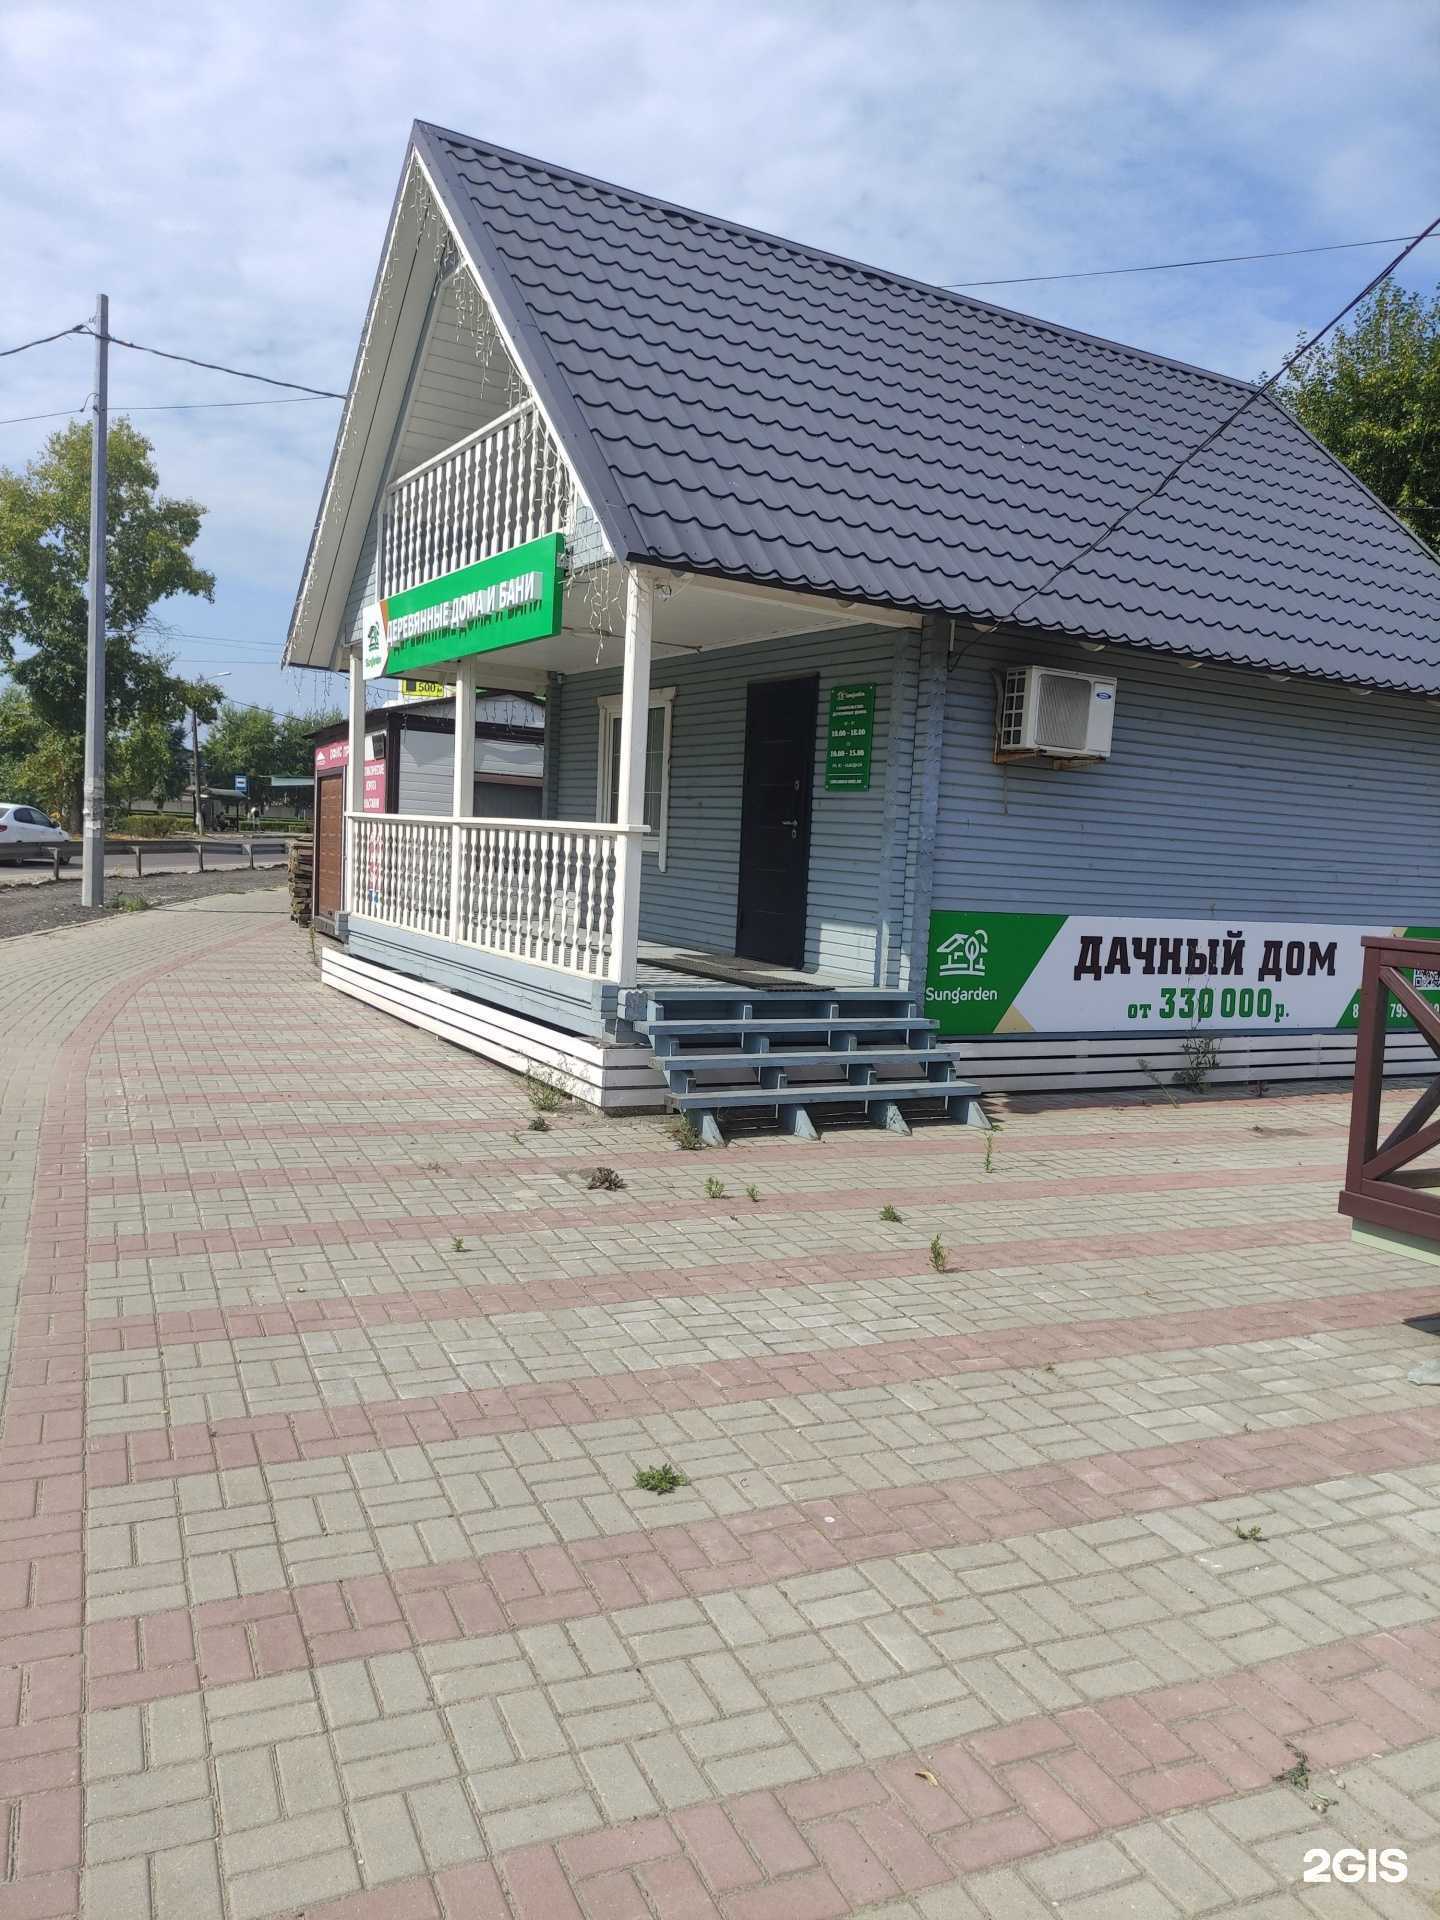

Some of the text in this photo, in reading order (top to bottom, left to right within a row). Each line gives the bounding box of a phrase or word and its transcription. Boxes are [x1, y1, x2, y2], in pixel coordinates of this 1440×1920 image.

[387, 570, 535, 647] ДЕРЕВЯННЫЕ ДОМА И БАНИ
[1073, 930, 1338, 982] ДАЧНЫЙ ДОМ
[925, 986, 998, 1004] Sungarden
[1127, 1003, 1152, 1019] от
[1159, 987, 1214, 1019] 330
